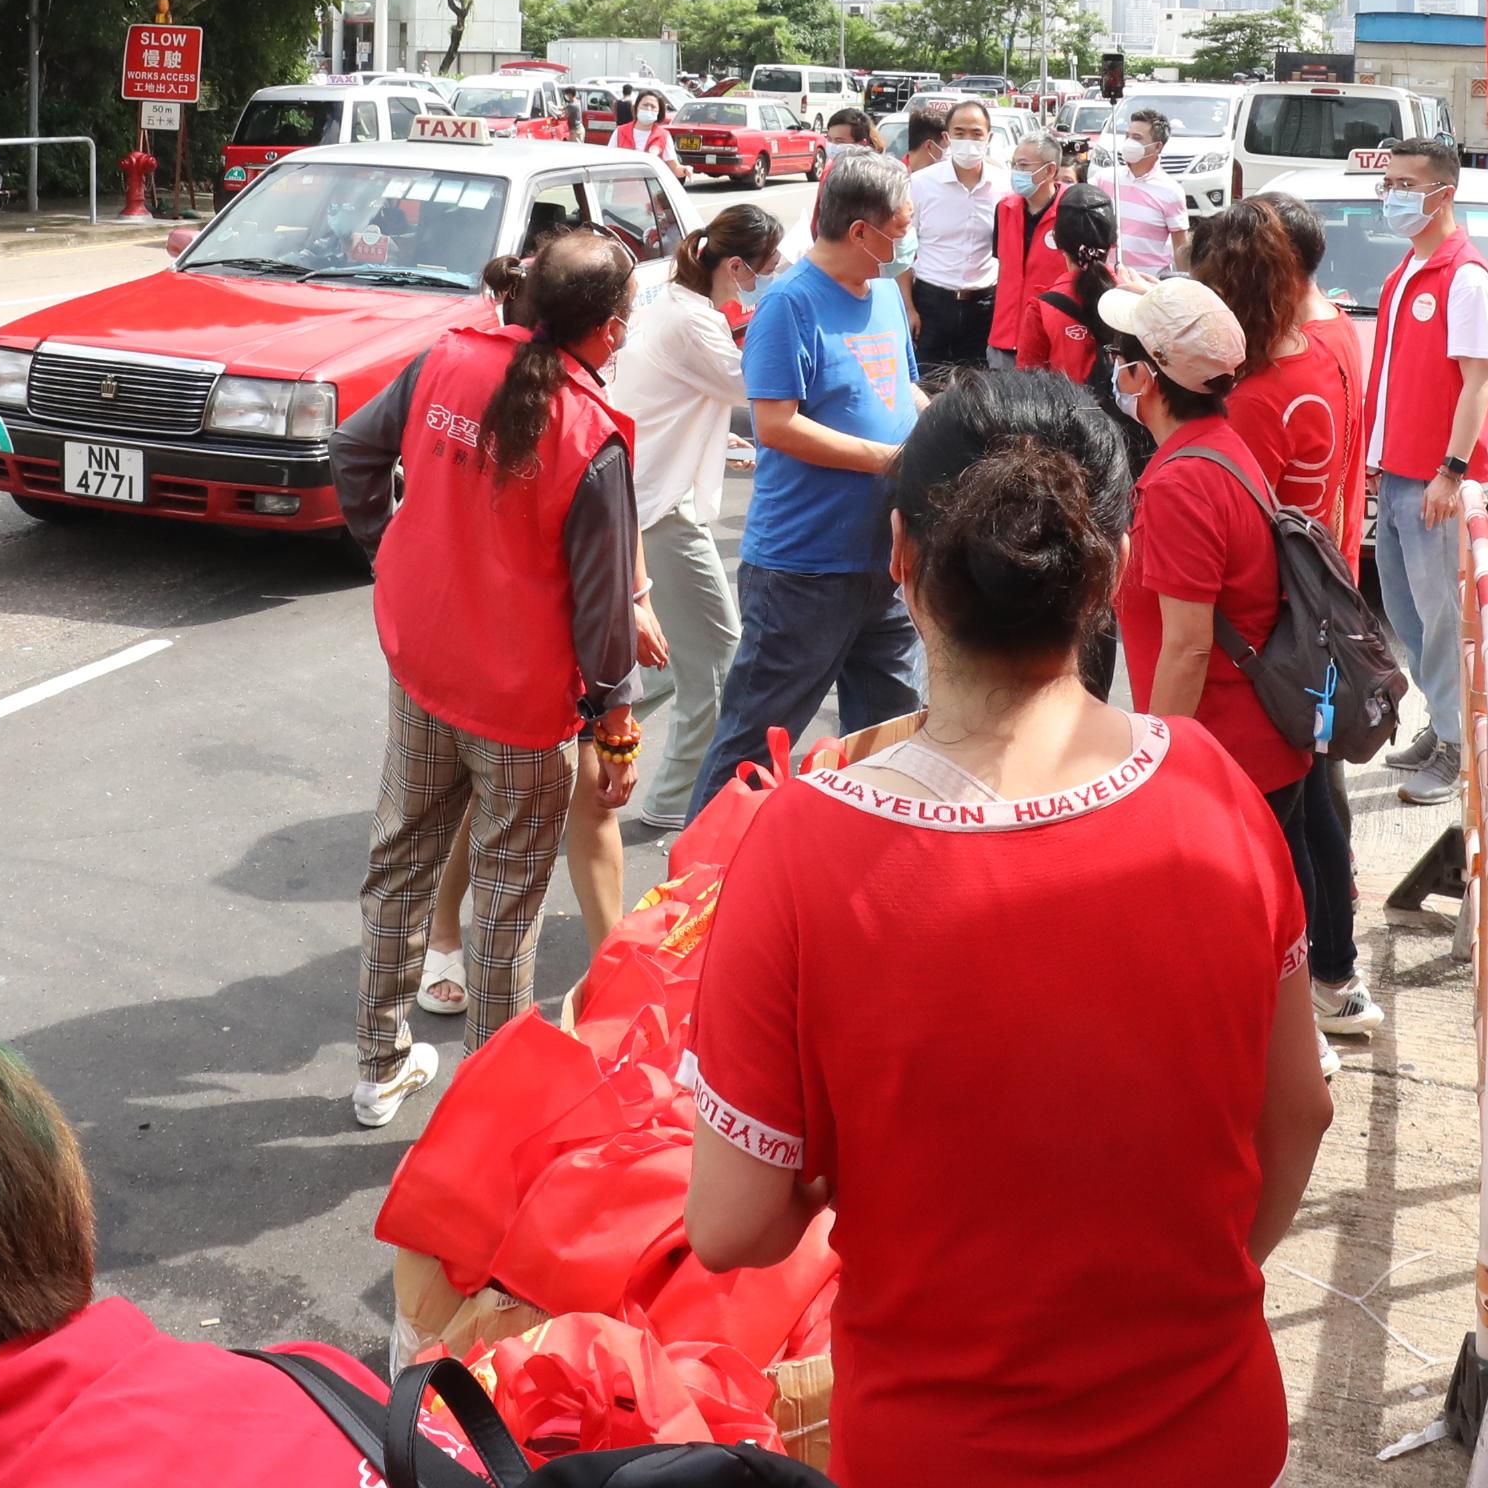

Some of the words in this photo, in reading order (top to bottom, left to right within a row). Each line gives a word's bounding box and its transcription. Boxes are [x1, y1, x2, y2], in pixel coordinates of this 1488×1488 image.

[140, 32, 187, 46] SLOW
[142, 49, 182, 68] 慢駛
[127, 71, 159, 80] WORKS
[160, 73, 196, 82] ACCESS
[329, 75, 358, 83] TAXI
[134, 82, 188, 94] 工地出入口
[152, 105, 164, 113] 50
[146, 116, 175, 126] 五十米
[416, 119, 477, 138] TAXI
[1355, 151, 1392, 168] TA
[88, 445, 120, 472] NN
[76, 470, 133, 499] 4771
[1151, 717, 1165, 740] HU
